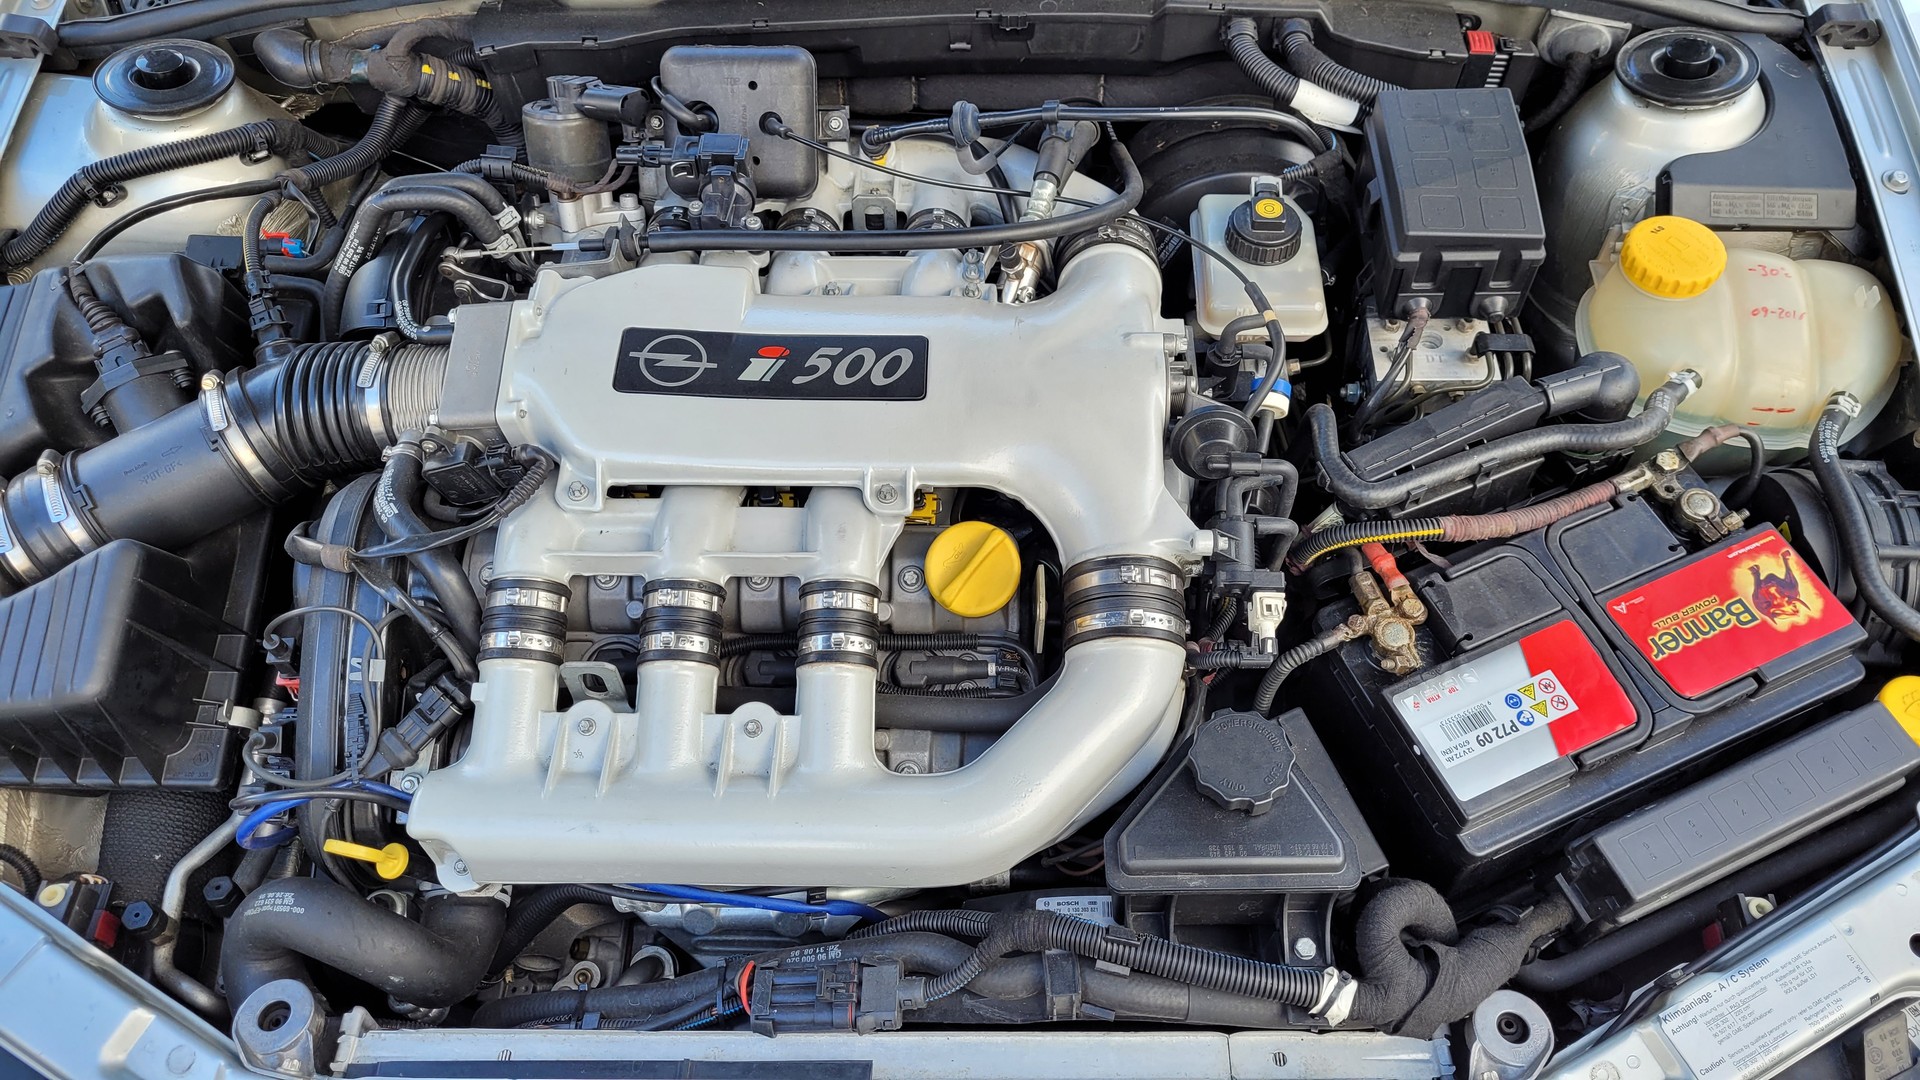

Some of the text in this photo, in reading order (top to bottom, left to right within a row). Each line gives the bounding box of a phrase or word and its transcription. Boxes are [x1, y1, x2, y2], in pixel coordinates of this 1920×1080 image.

[337, 263, 347, 274] GM
[792, 347, 914, 387] 500
[1652, 595, 1717, 629] POWER BULL
[1647, 595, 1759, 660] Banner
[1426, 692, 1441, 703] XTRA
[1446, 684, 1458, 694] TOP
[1473, 717, 1520, 749] P72 09
[282, 897, 294, 905] GM
[816, 952, 827, 961] 90
[827, 949, 842, 959] GM
[1846, 952, 1864, 975] 135 157
[1661, 988, 1713, 1023] Klimaanlage
[1716, 980, 1726, 992] A
[1729, 973, 1739, 984] C
[1737, 954, 1771, 981] System
[1698, 1005, 1717, 1020] Wartung
[1715, 1001, 1724, 1009] nur
[1723, 993, 1736, 1004] durch
[1801, 943, 1818, 957] Service
[1727, 1046, 1744, 1060] Service
[1742, 1042, 1751, 1050] by
[1748, 1031, 1768, 1046] qualified
[1766, 1019, 1788, 1036] personnel
[1797, 1007, 1808, 1016] refer
[1811, 997, 1824, 1008] GME
[1822, 988, 1839, 1001] service
[1837, 974, 1861, 992] instructions
[1803, 1004, 1827, 1022] Refrigerant
[1670, 1014, 1700, 1037] Achtung!
[1731, 1025, 1743, 1036] GME
[1731, 1048, 1757, 1067] Compressor
[1758, 1040, 1769, 1050] PAG
[1698, 1055, 1726, 1077] Caution!
